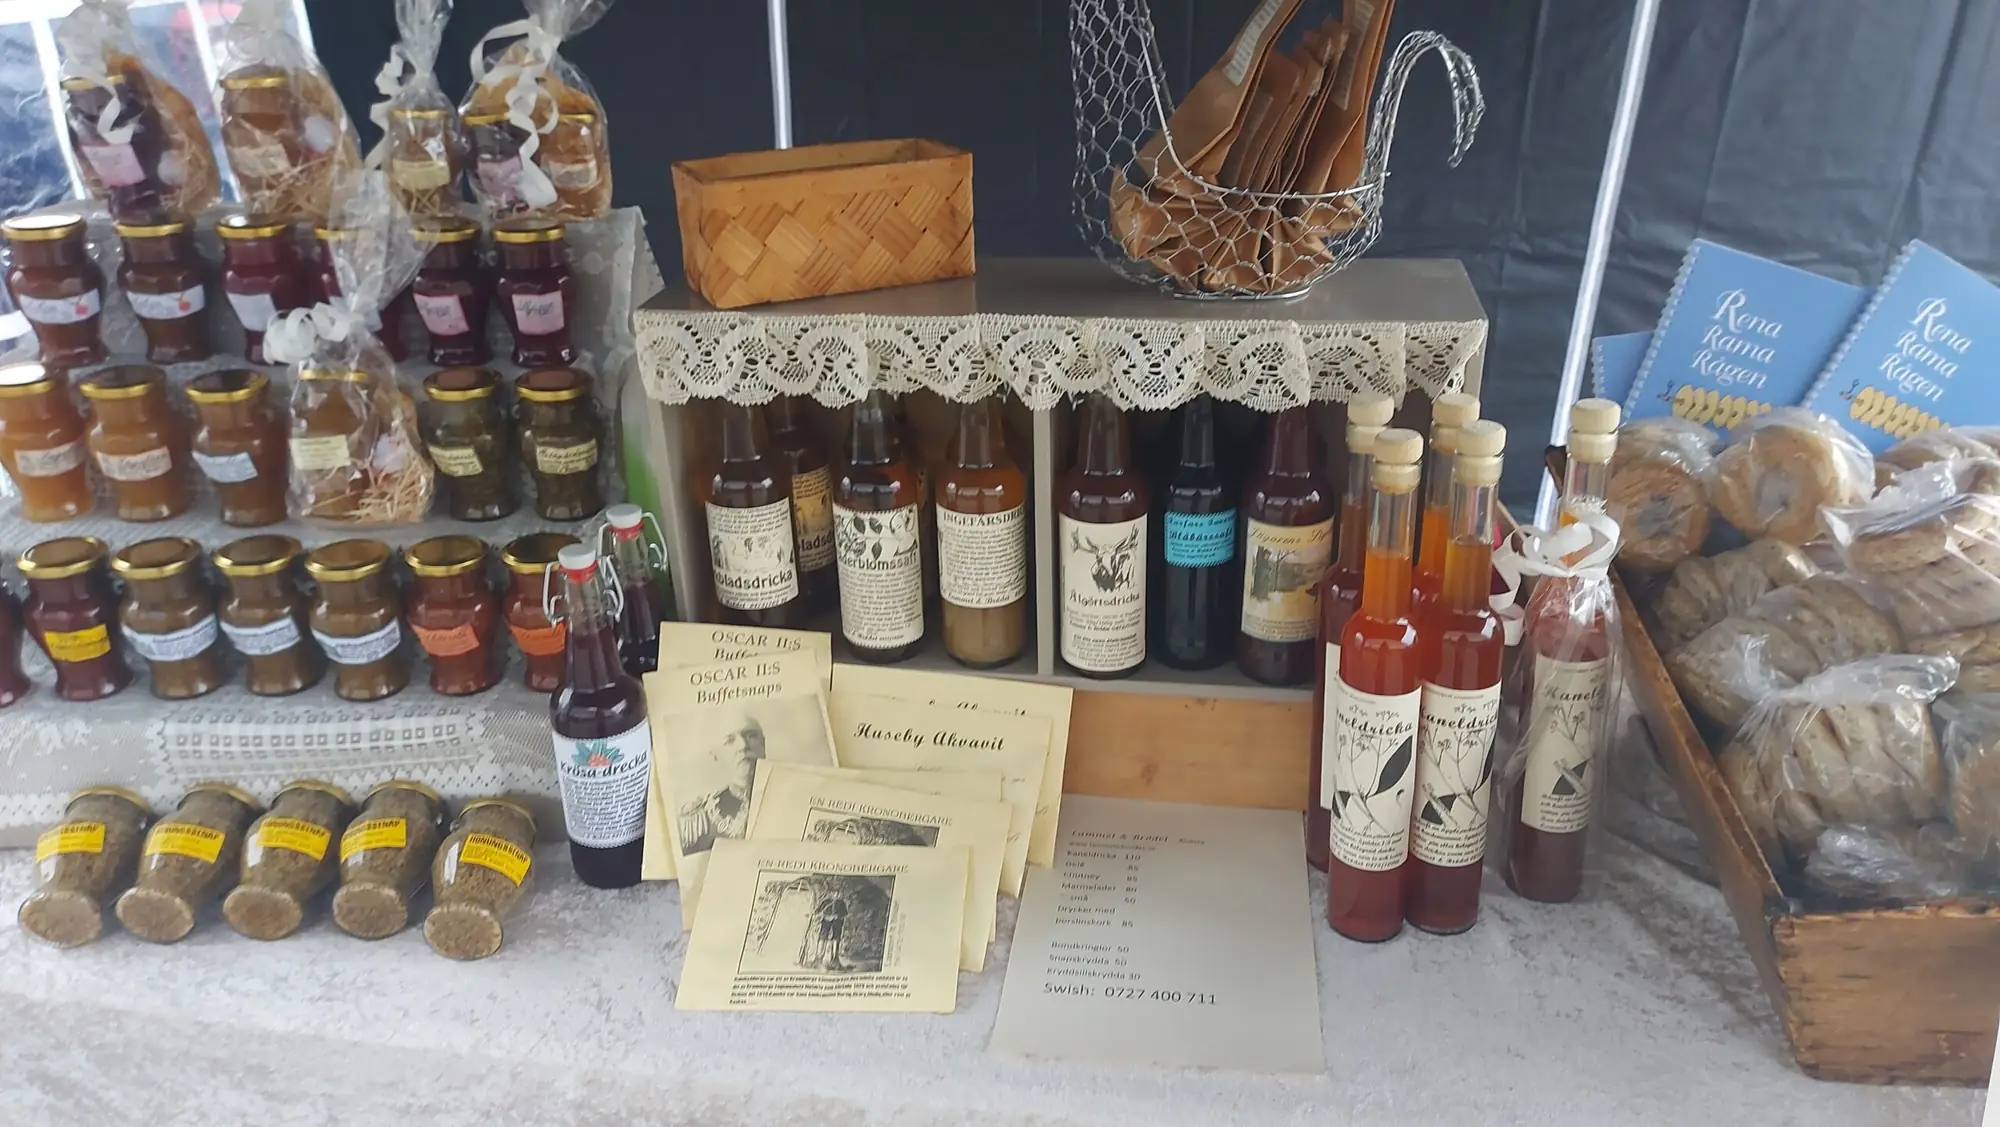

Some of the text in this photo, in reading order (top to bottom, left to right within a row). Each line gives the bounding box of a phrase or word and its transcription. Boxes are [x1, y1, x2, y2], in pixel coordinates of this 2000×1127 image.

[1711, 288, 1783, 338] Rena
[1909, 298, 1972, 354] Rena
[1702, 324, 1776, 364] Rama
[1896, 330, 1959, 379] Rama
[1689, 349, 1768, 389] Rågen
[1879, 353, 1944, 403] Rågen
[711, 630, 802, 651] OSCAR II:S
[690, 661, 781, 686] OSCAR II:S
[697, 682, 782, 705] Buffetsnaps
[853, 722, 1005, 751] Huseby Akvavit
[809, 795, 826, 806] EN
[757, 859, 775, 868] EN
[1063, 872, 1100, 880] Chutney
[1061, 882, 1116, 891] Marmelader
[1043, 982, 1217, 1006] Swish: 0727 400 711
